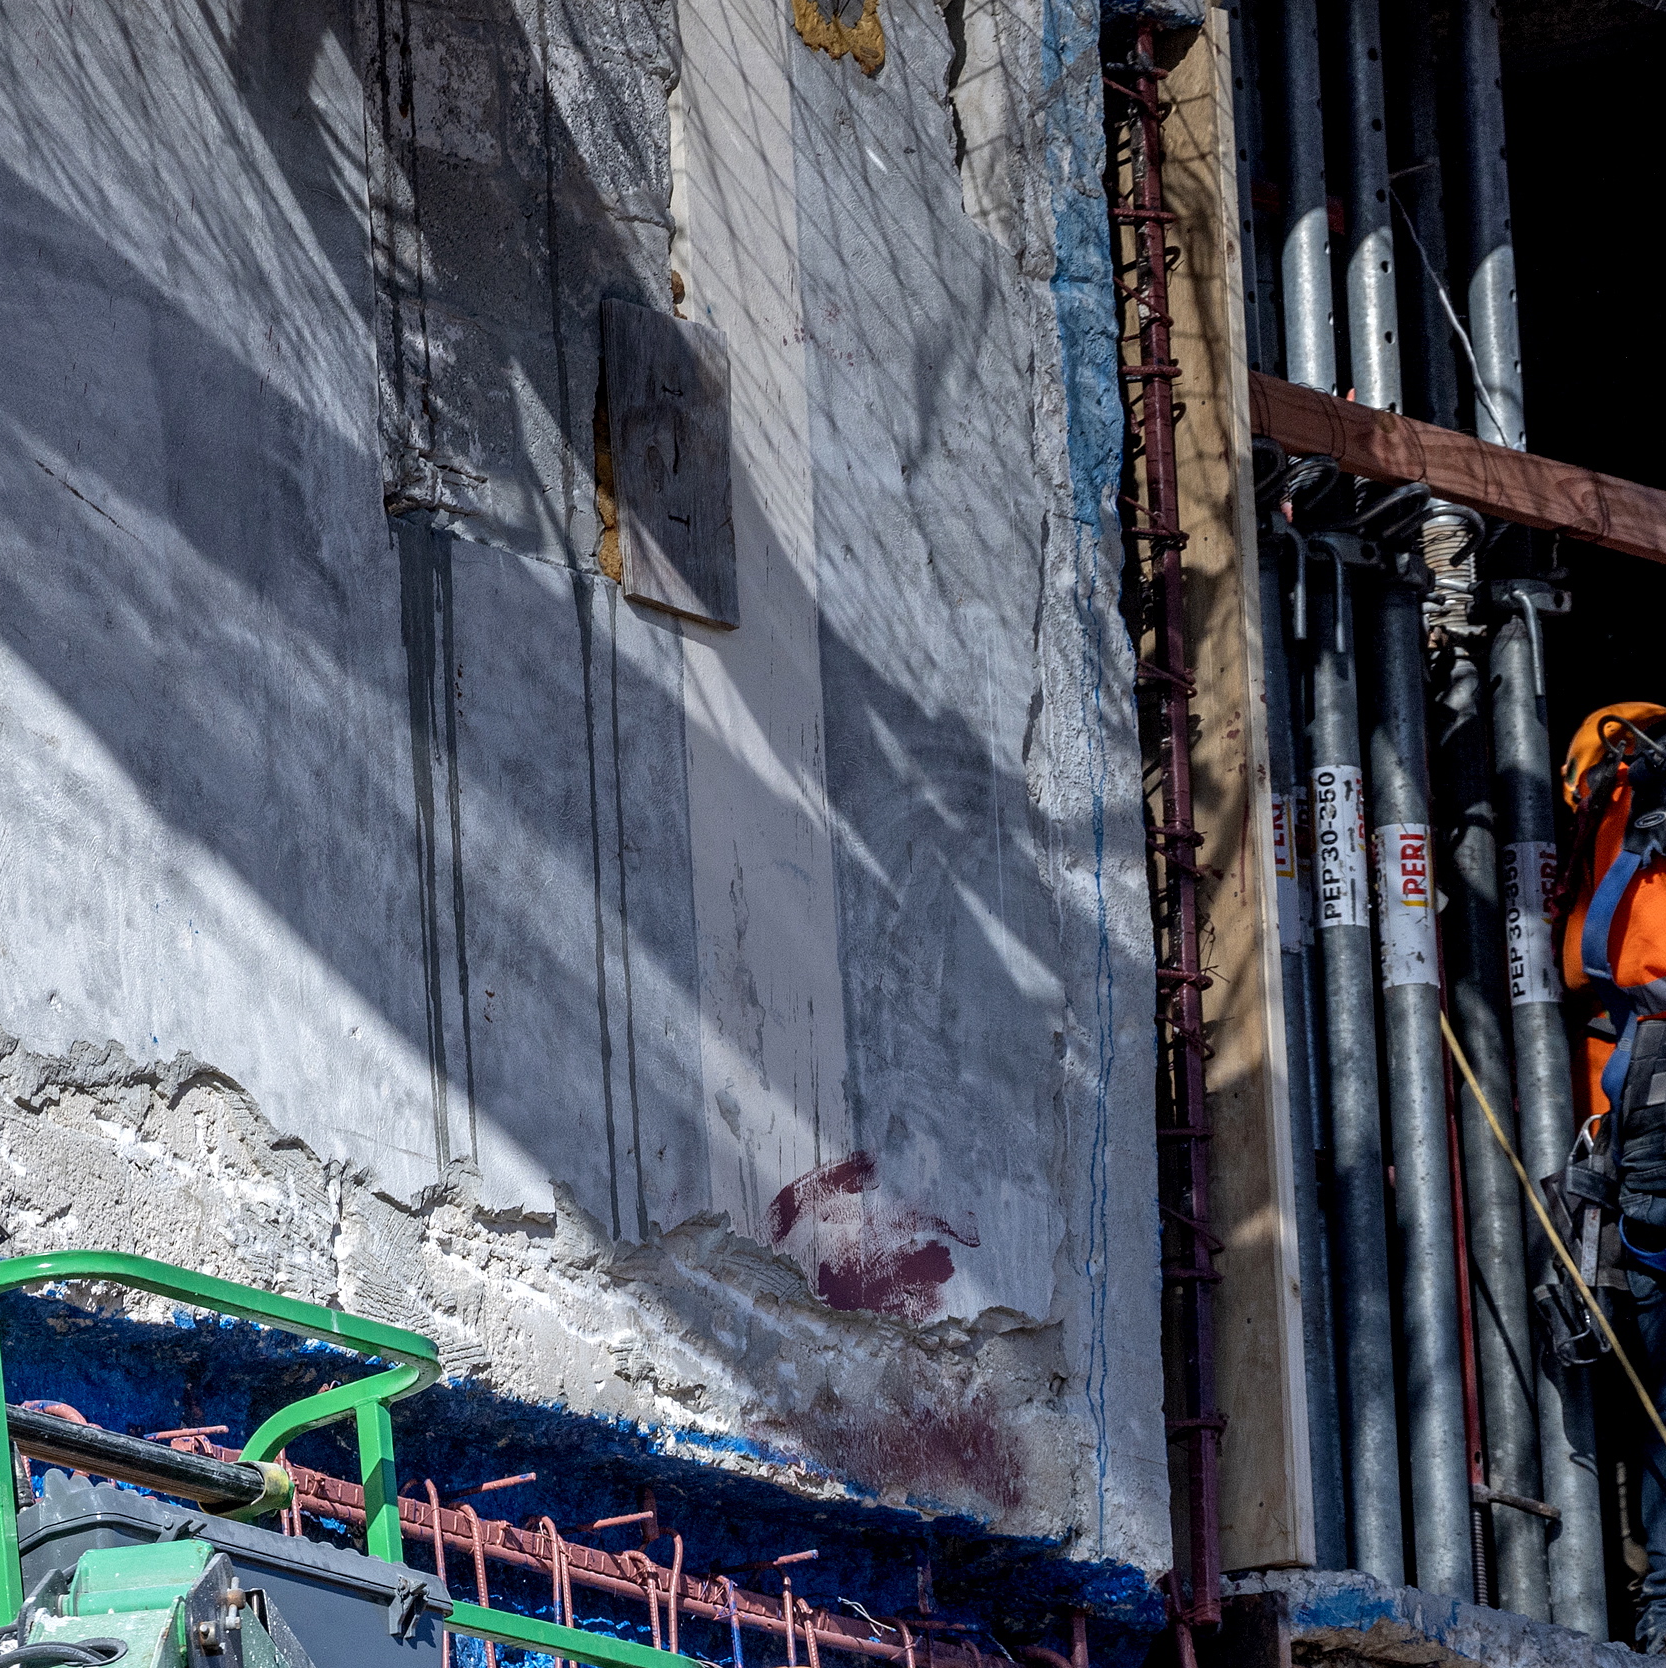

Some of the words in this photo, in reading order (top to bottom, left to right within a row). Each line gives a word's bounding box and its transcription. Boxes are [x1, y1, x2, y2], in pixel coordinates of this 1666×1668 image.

[1399, 834, 1427, 895] PERI
[1322, 868, 1342, 920] PEP
[1510, 946, 1526, 998] PEP
